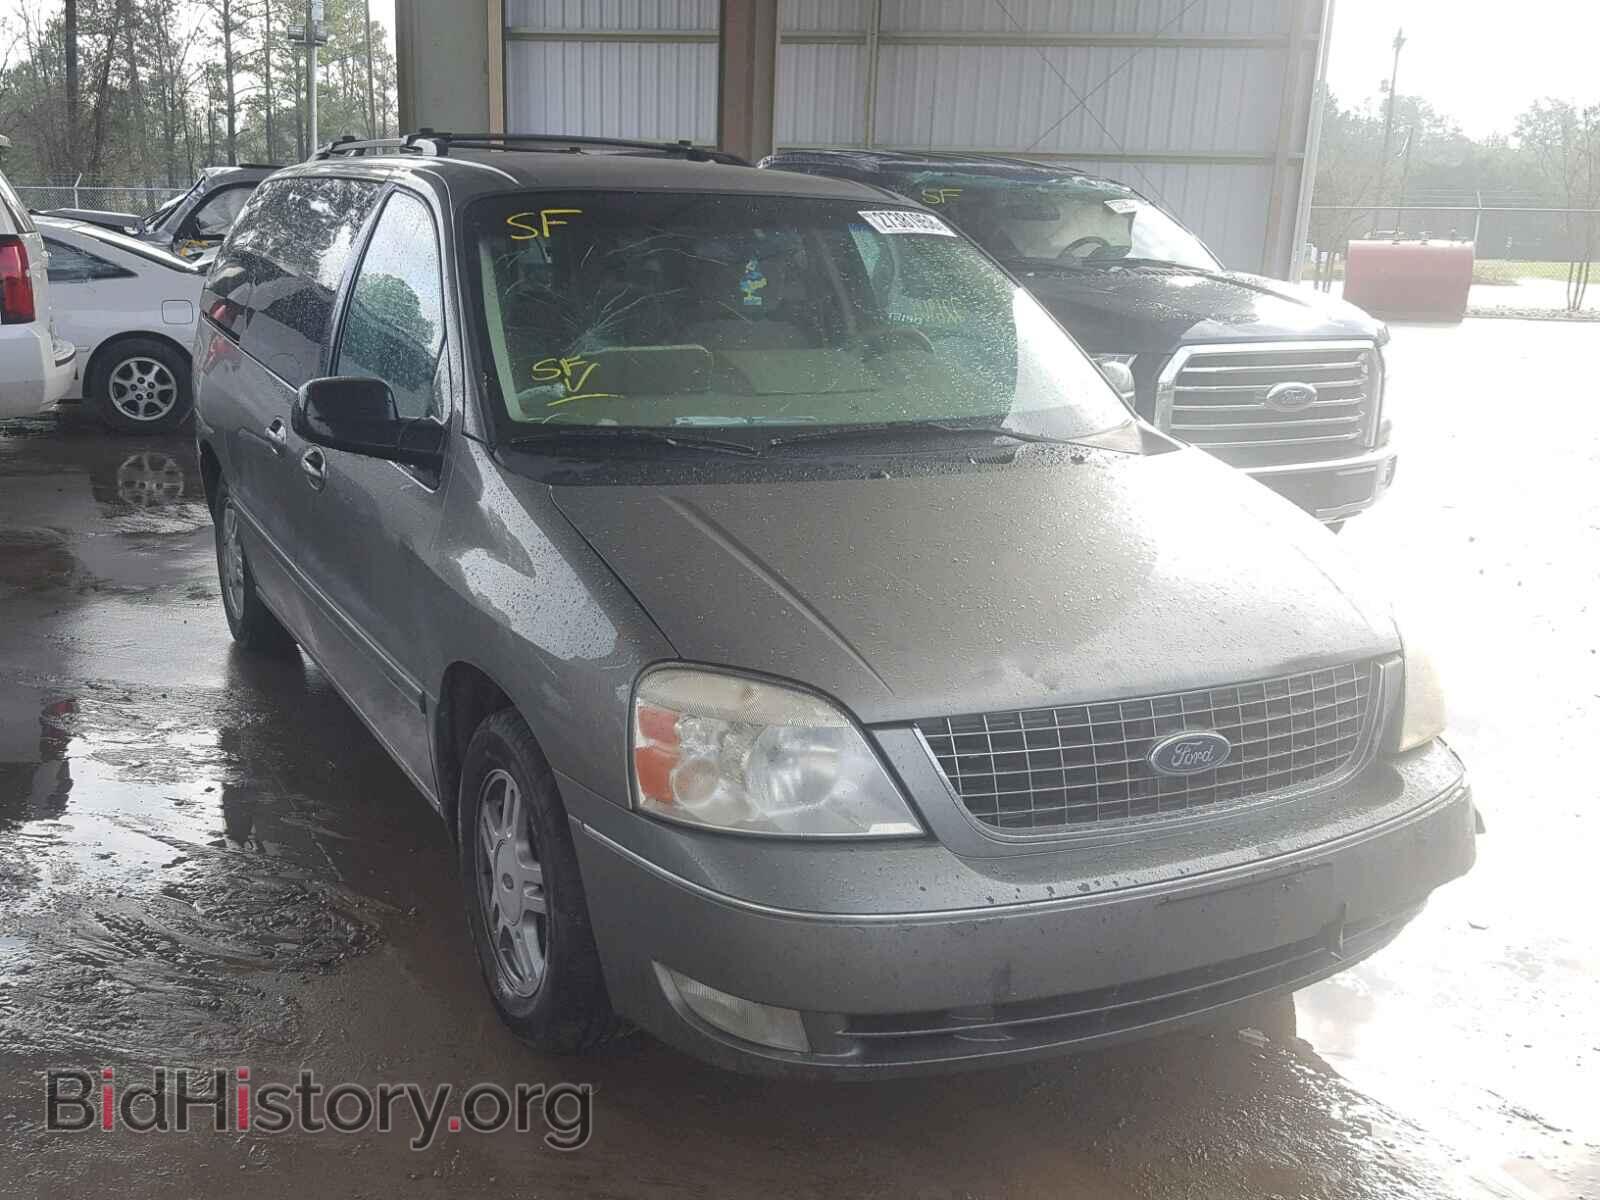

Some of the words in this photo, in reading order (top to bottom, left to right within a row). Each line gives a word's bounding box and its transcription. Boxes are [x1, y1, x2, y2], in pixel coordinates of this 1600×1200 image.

[920, 188, 965, 204] SF
[506, 209, 584, 240] SF
[1170, 741, 1215, 767] Ford
